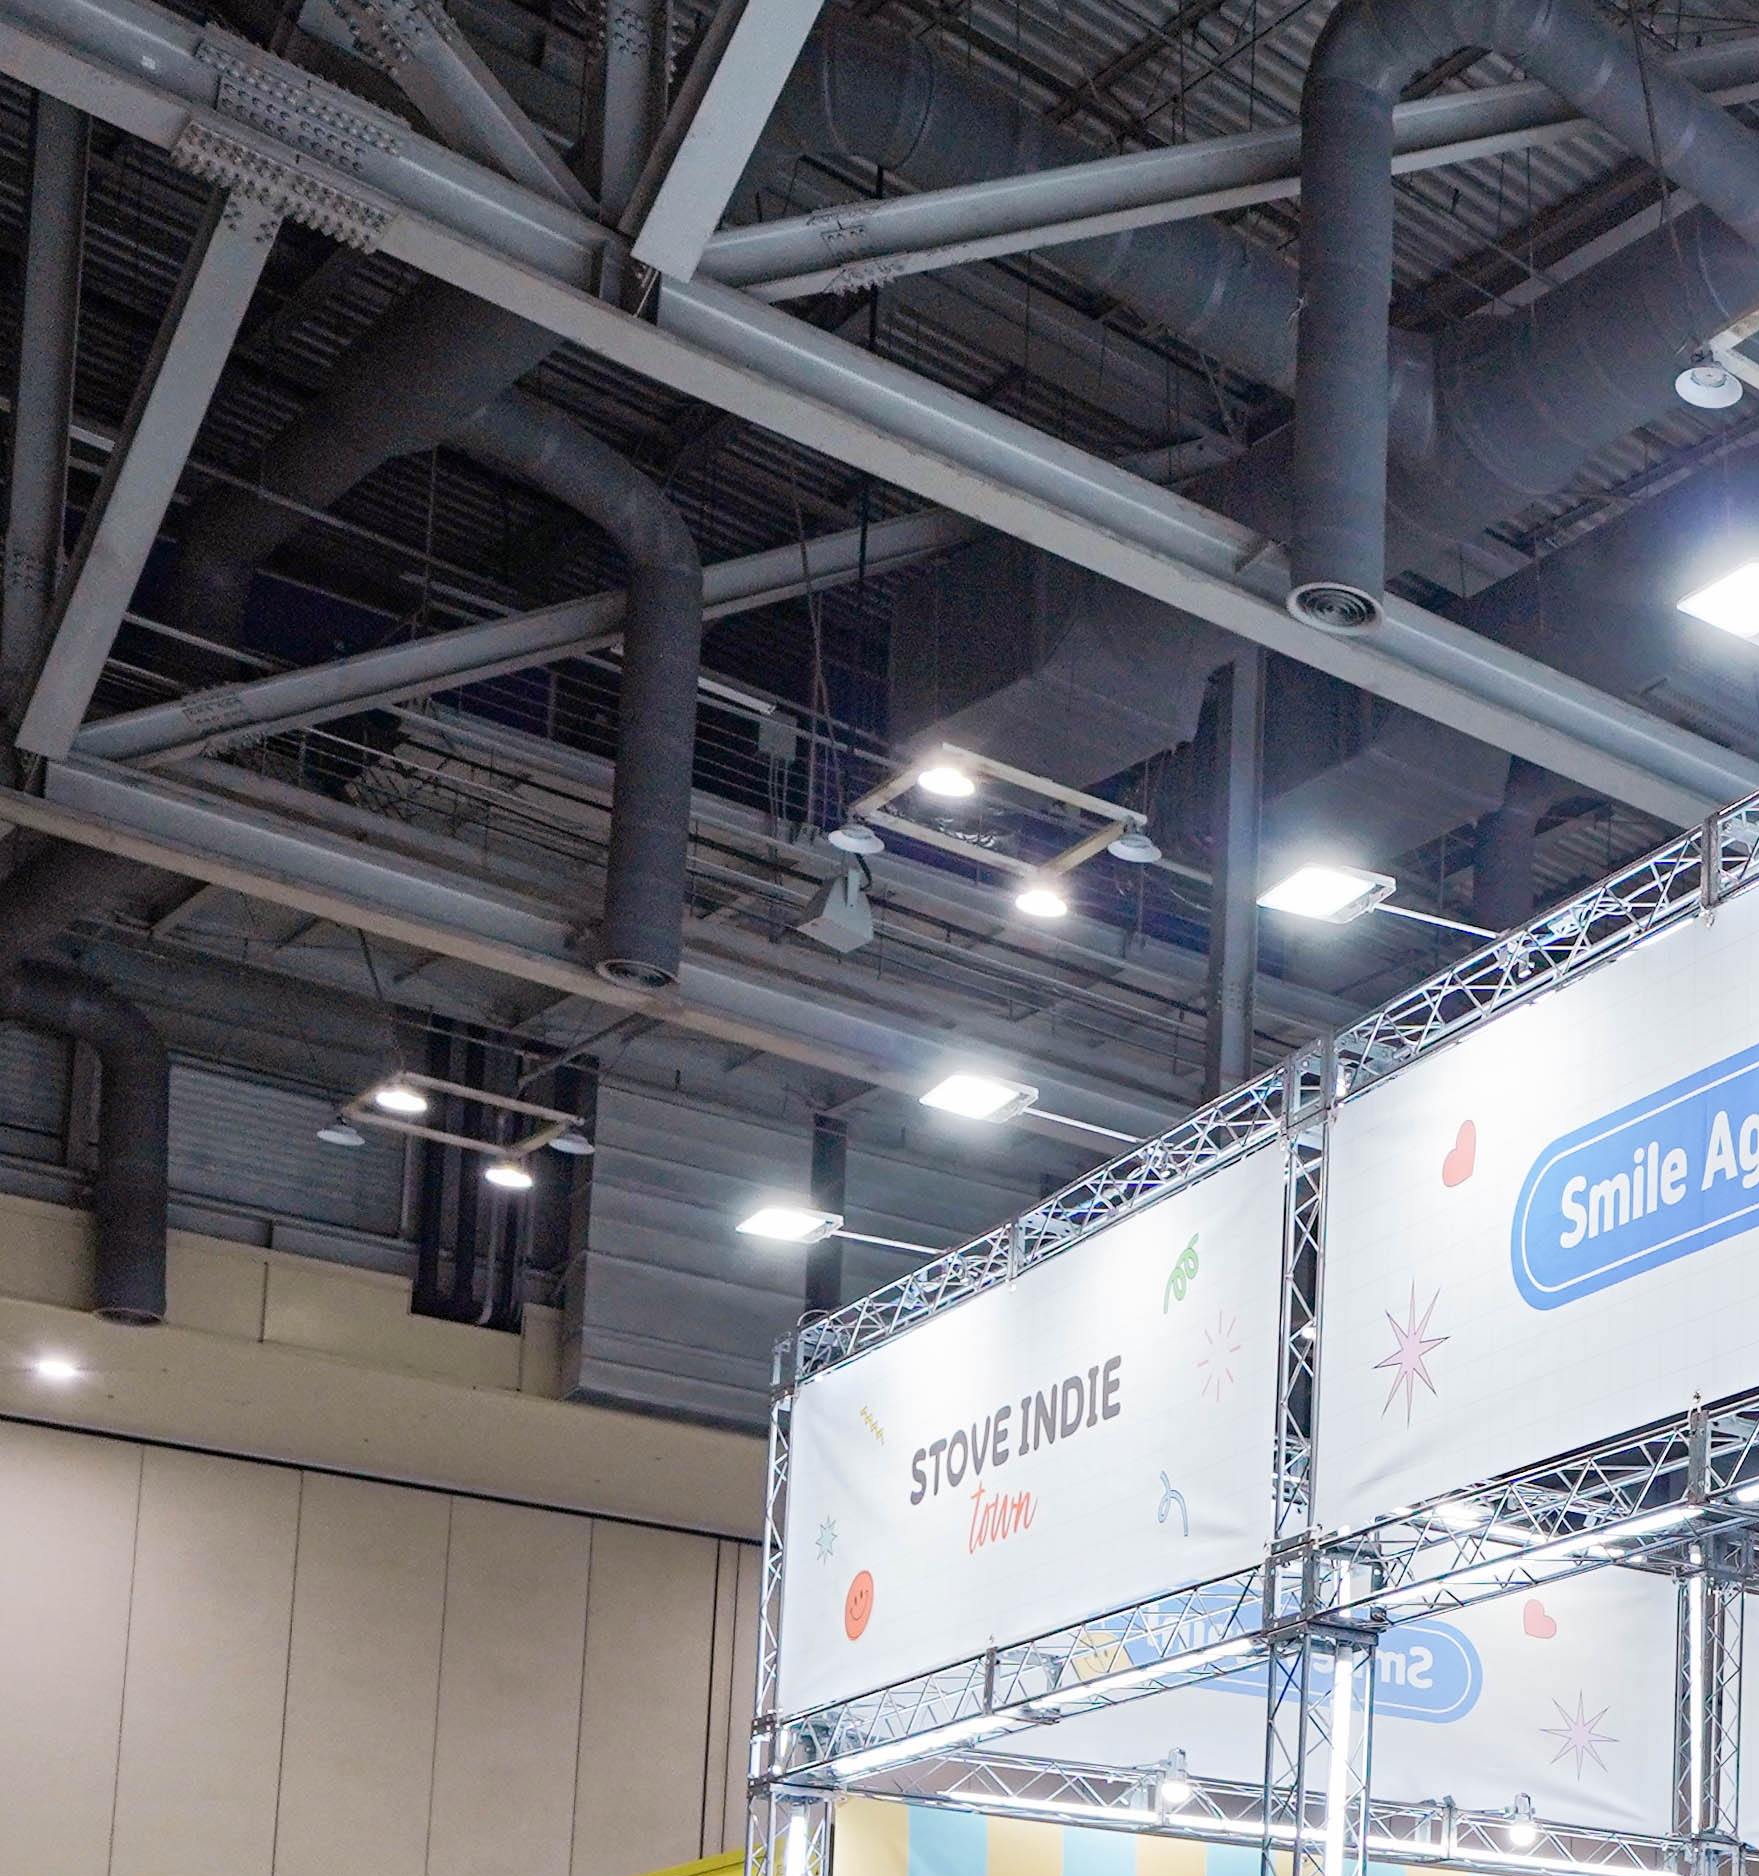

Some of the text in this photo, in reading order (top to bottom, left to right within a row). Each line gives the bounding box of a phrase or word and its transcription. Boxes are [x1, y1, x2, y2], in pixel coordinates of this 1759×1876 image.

[1559, 1141, 1688, 1249] Smile
[910, 1355, 1122, 1505] STOVE INDIE
[969, 1480, 1038, 1554] town
